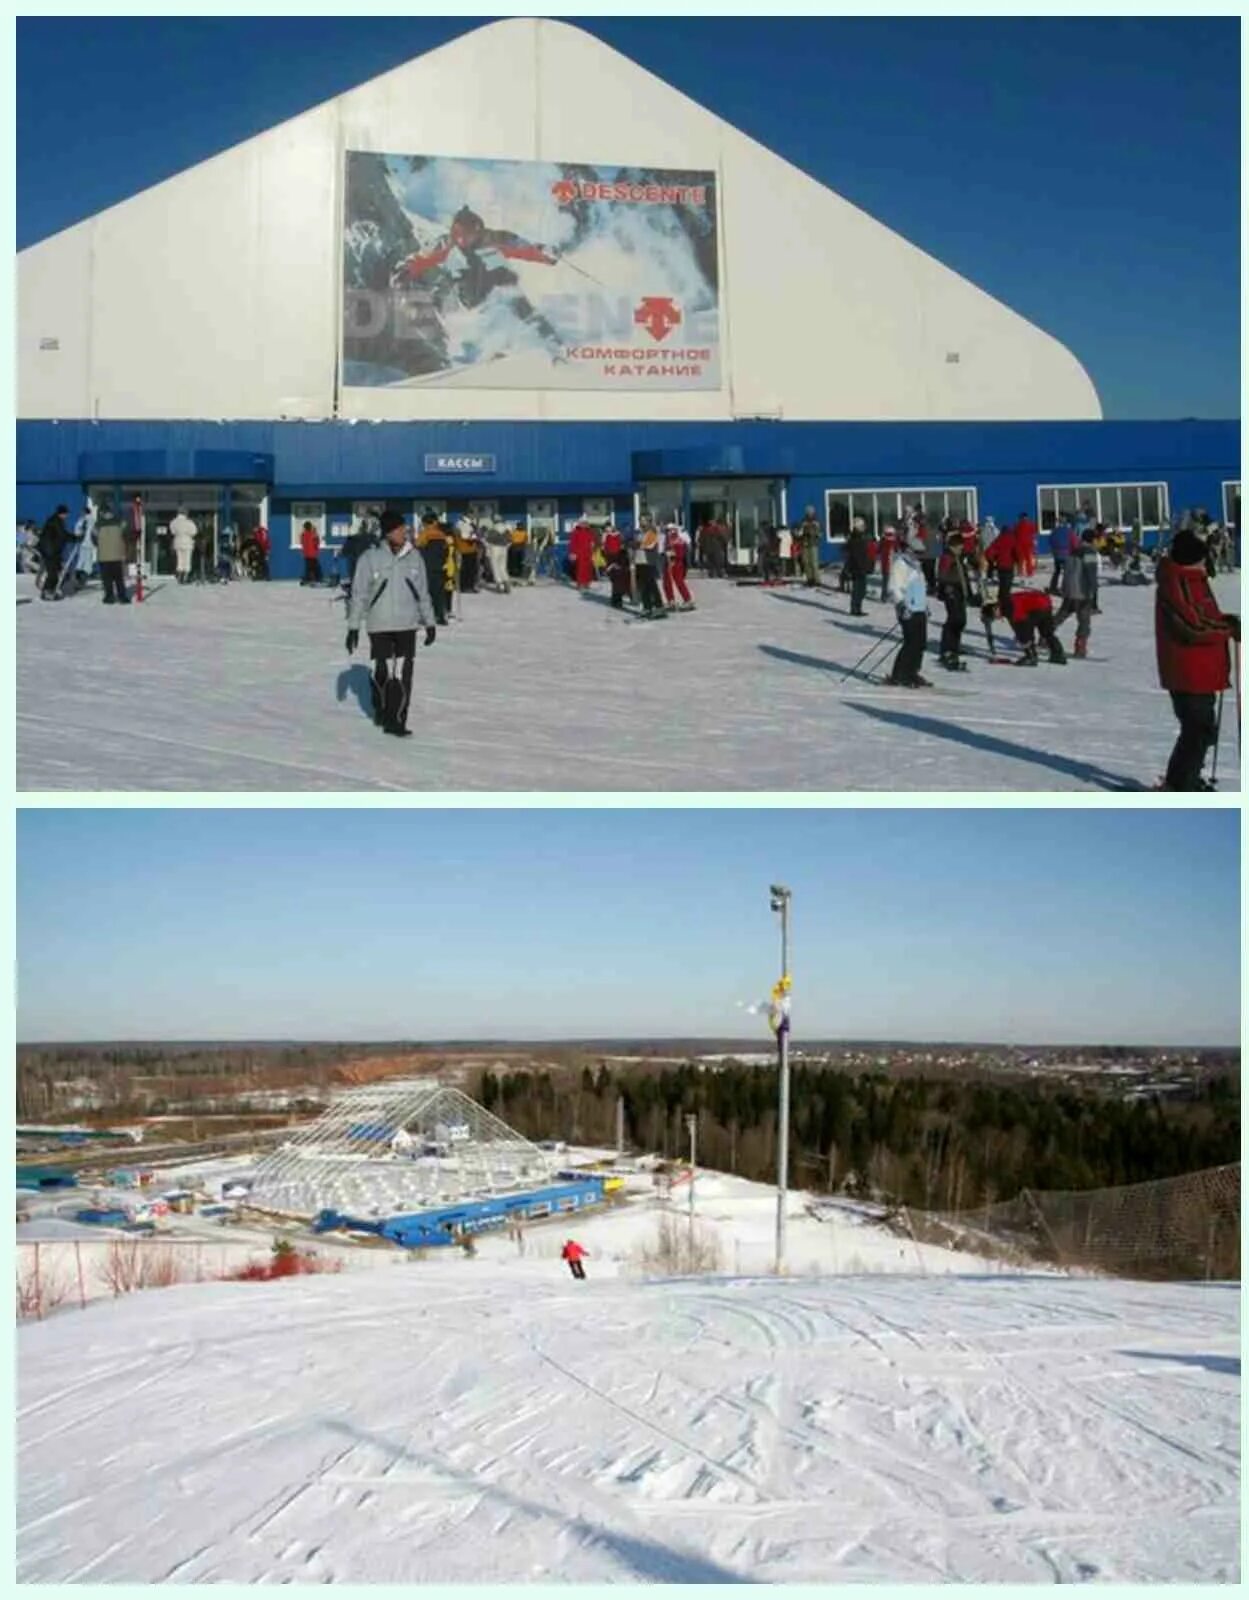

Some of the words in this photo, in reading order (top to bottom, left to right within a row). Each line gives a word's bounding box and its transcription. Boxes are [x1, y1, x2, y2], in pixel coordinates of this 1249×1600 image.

[582, 182, 706, 204] DESCENTE
[343, 288, 720, 342] DEENE
[566, 347, 711, 361] КОМФОРТНОЕ
[603, 364, 703, 377] КАТАНИЕ
[438, 457, 483, 469] КАССЫ
